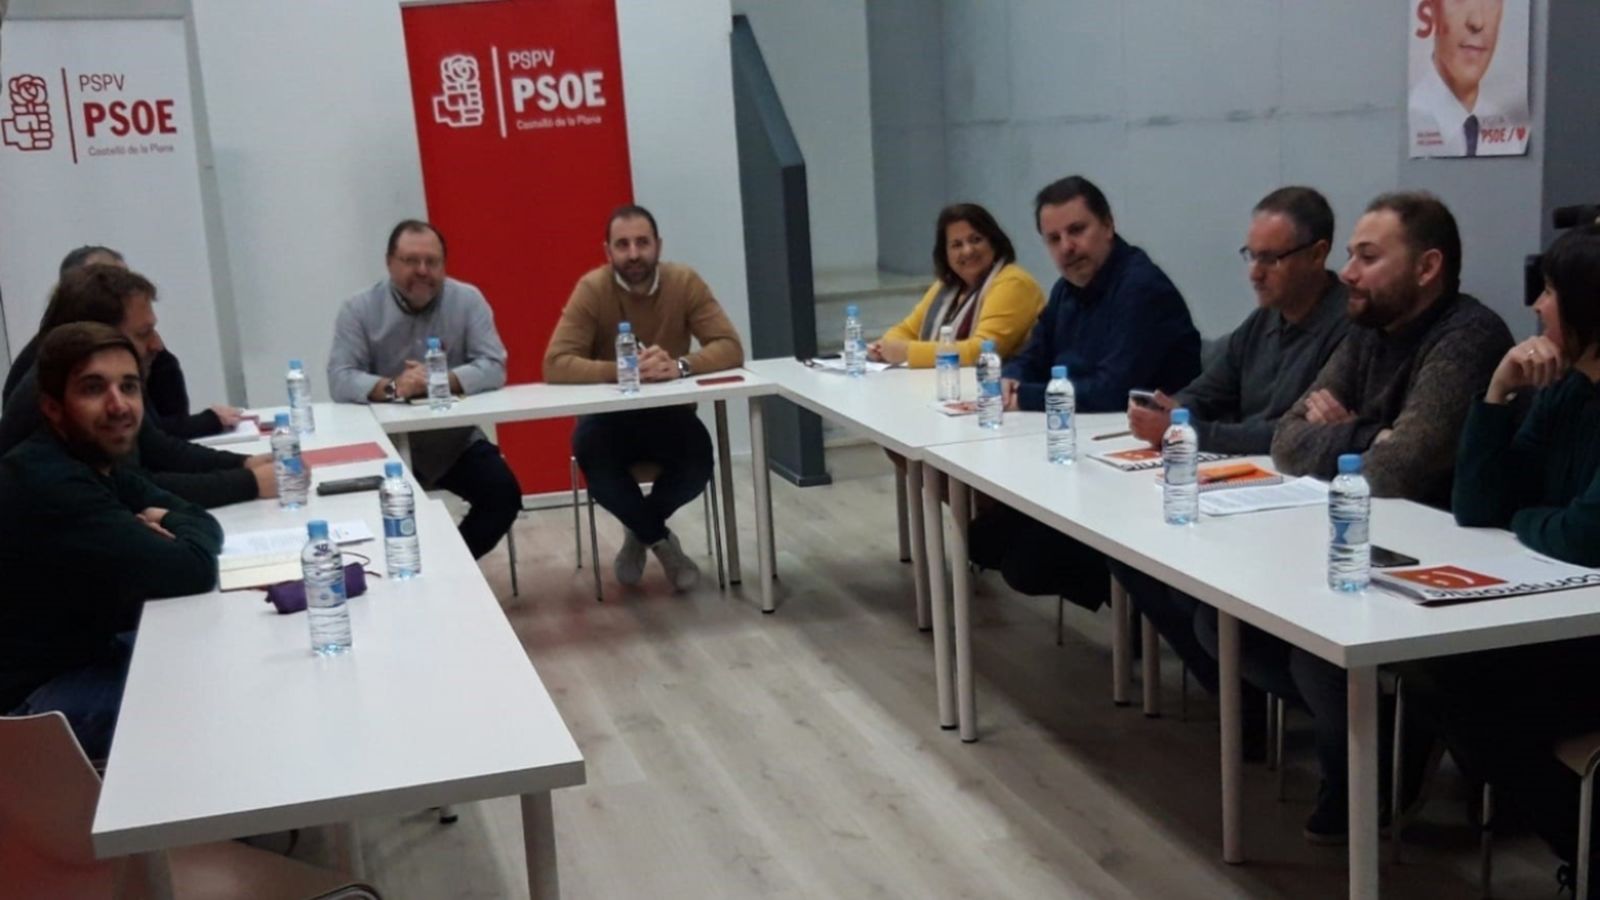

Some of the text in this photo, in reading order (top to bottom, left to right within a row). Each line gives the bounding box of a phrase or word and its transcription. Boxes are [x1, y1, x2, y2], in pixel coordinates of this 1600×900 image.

[508, 49, 555, 70] PSPV
[79, 73, 125, 92] PSPV
[511, 70, 606, 113] PSOE
[83, 99, 177, 138] PSOE
